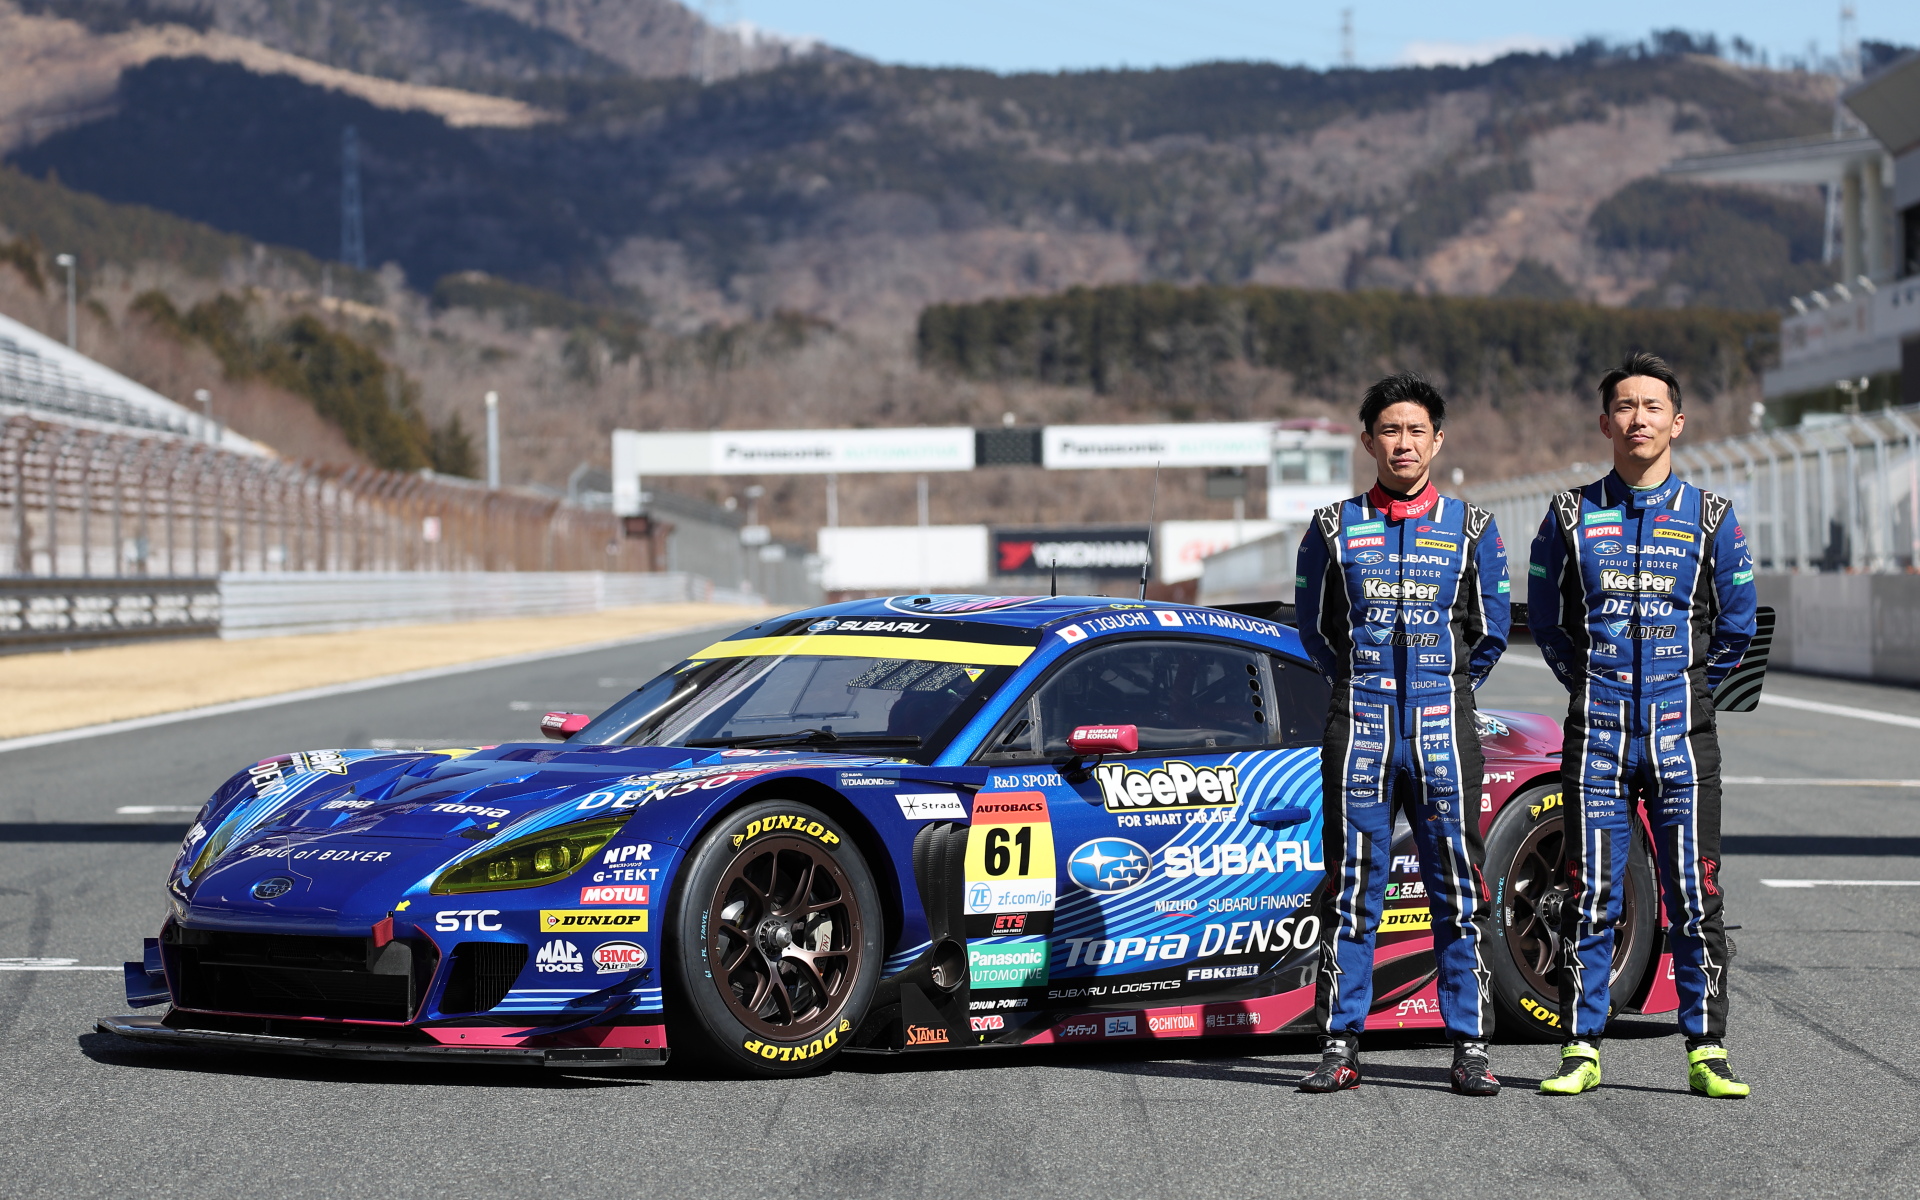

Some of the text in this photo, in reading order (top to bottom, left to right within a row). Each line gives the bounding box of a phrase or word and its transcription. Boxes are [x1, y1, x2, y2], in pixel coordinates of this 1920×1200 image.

[726, 446, 833, 459] Panasonic
[1061, 440, 1166, 456] Panasonic
[1406, 500, 1431, 515] BRZ
[1587, 511, 1619, 521] Panasonic
[1349, 523, 1382, 533] Panasonic
[1587, 525, 1621, 537] MOTUL
[1661, 531, 1692, 540] DUNLOP
[1350, 537, 1384, 548] MOTUL
[1424, 541, 1455, 549] DUNLOP
[1626, 544, 1687, 558] SUBARU
[1388, 553, 1450, 566] SUBARU
[1598, 559, 1629, 567] Proud
[1646, 560, 1679, 570] BOXER
[1361, 568, 1391, 576] Proud
[1409, 569, 1441, 578] BOXER
[1600, 570, 1677, 592] KeePer
[1363, 578, 1440, 600] KeePer
[1601, 598, 1673, 616] DENSO
[1091, 611, 1150, 634] T.IGUCHI
[1365, 607, 1440, 625] DENSO
[837, 620, 931, 633] SUBARU
[1182, 611, 1281, 638] H.YAMAUCHI
[1356, 650, 1381, 661] NPR
[1595, 641, 1618, 655] NPR
[1655, 645, 1683, 656] STC
[1419, 654, 1446, 664] STC
[1423, 704, 1449, 715] BBS
[1661, 711, 1682, 721] BBS
[1662, 754, 1686, 767] SPK
[993, 773, 1063, 789] R&D SPORT
[1096, 761, 1238, 810] KeePer
[1351, 773, 1375, 784] SPK
[575, 773, 739, 812] DENSO
[921, 802, 961, 810] Strada
[975, 802, 1043, 813] AUTOBACS
[1117, 810, 1237, 828] FOR SMART CAR LIFE
[745, 815, 841, 845] DUNLOP
[241, 844, 392, 863] Proud of BOXER
[602, 843, 652, 865] NPR
[984, 826, 1032, 876] 61
[1164, 839, 1325, 879] SUBARU
[593, 868, 660, 883] G-TEKT
[584, 887, 646, 902] MOTUL
[970, 889, 990, 907] ZF
[997, 890, 1052, 906] zf.com/jp
[1154, 899, 1198, 912] MIZUHO
[1208, 893, 1312, 913] SUBARU FINANCE
[435, 909, 503, 932] STC
[562, 915, 641, 926] DUNLOP
[995, 914, 1026, 928] ETS
[1197, 915, 1320, 958] DENSO
[536, 939, 583, 964] MAC
[598, 948, 642, 963] BMC
[969, 948, 1042, 967] Panasonic
[535, 963, 584, 973] TOOLS
[600, 961, 638, 971] Air Filter
[1187, 967, 1226, 982] FBK
[1048, 979, 1181, 999] SUBARU LOGISTICS
[996, 998, 1028, 1009] POWER
[969, 1015, 1004, 1031] KYB
[1066, 1023, 1098, 1036] ダイテック
[1158, 1015, 1195, 1031] CHIYODA
[906, 1024, 950, 1046] STANLEY
[743, 1026, 840, 1062] DUNLOP
